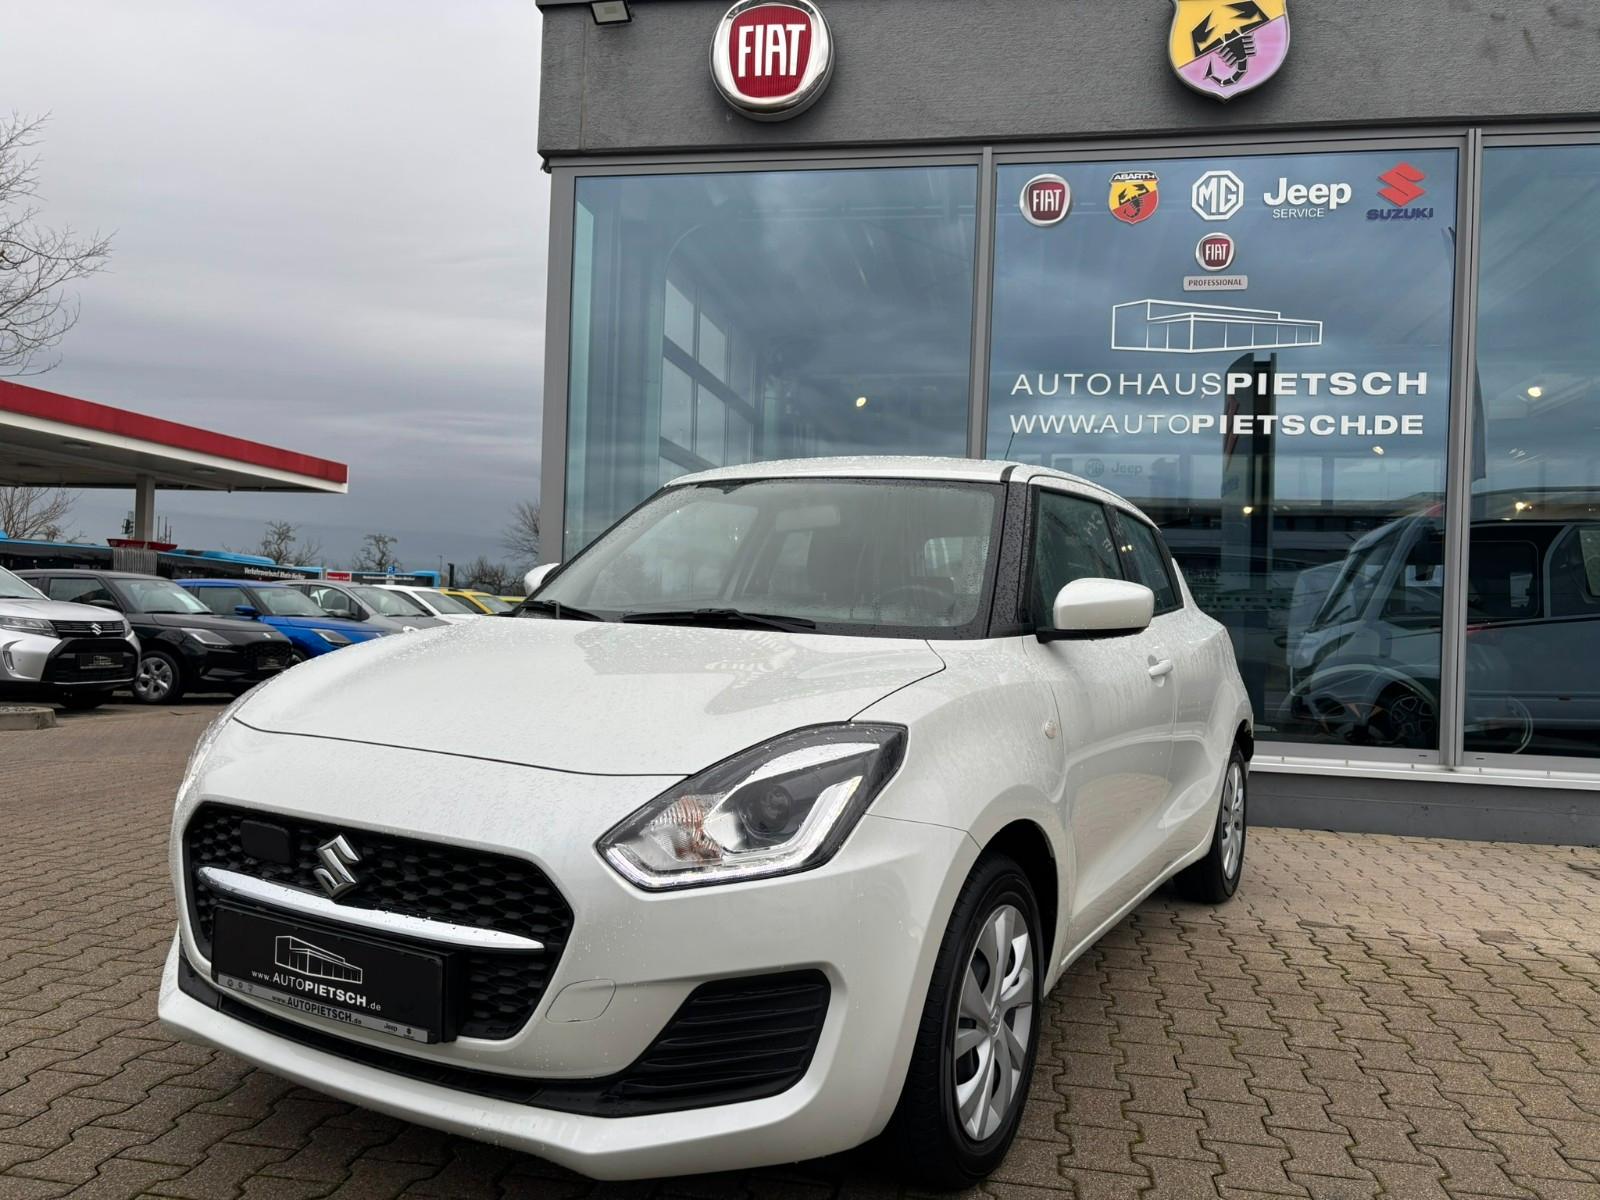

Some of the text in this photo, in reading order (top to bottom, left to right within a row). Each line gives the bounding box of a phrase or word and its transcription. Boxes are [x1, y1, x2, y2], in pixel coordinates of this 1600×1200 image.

[738, 24, 806, 78] FIAT
[1113, 173, 1156, 181] ABARTH
[1032, 188, 1063, 212] FIAT
[1198, 177, 1238, 214] MG
[1263, 177, 1352, 210] Jeep
[1272, 208, 1326, 219] SERVICE
[1366, 208, 1434, 220] SUZUKI
[1205, 243, 1229, 261] FIAT
[1188, 278, 1243, 287] PROFESSIONAL
[1009, 414, 1424, 436] WWW.AUTOPIETSCH.DE
[251, 969, 382, 1012] www.AUTOPIETSCH.de
